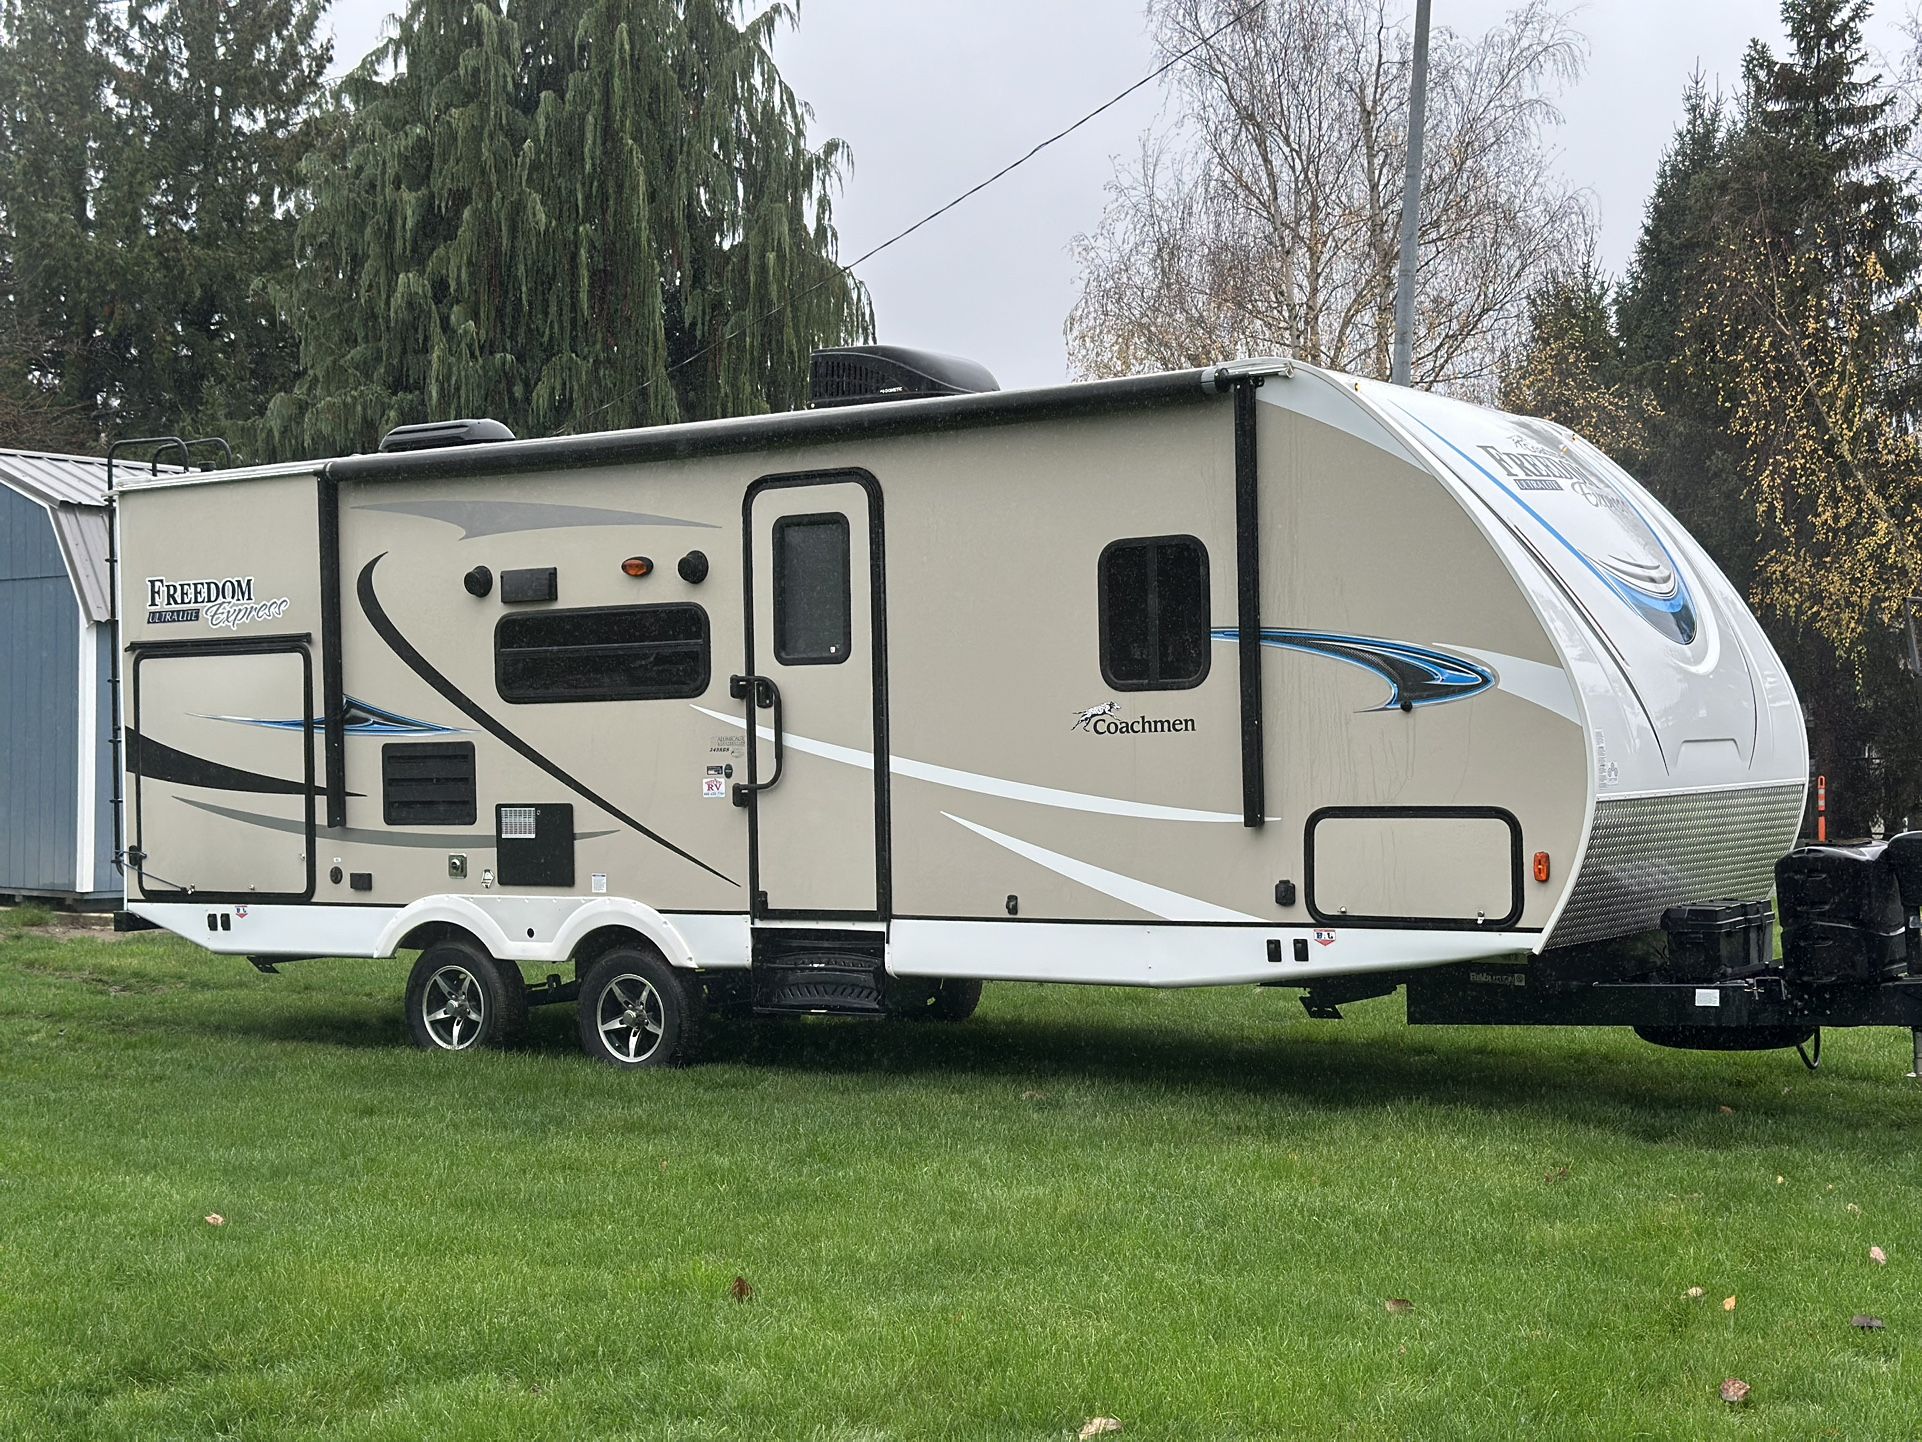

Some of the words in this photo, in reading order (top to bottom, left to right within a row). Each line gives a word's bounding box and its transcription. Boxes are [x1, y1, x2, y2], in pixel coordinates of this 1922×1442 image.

[148, 578, 253, 607] FREEDOM
[205, 599, 288, 627] Express
[1093, 715, 1196, 734] Coachmen
[707, 783, 722, 791] RV
